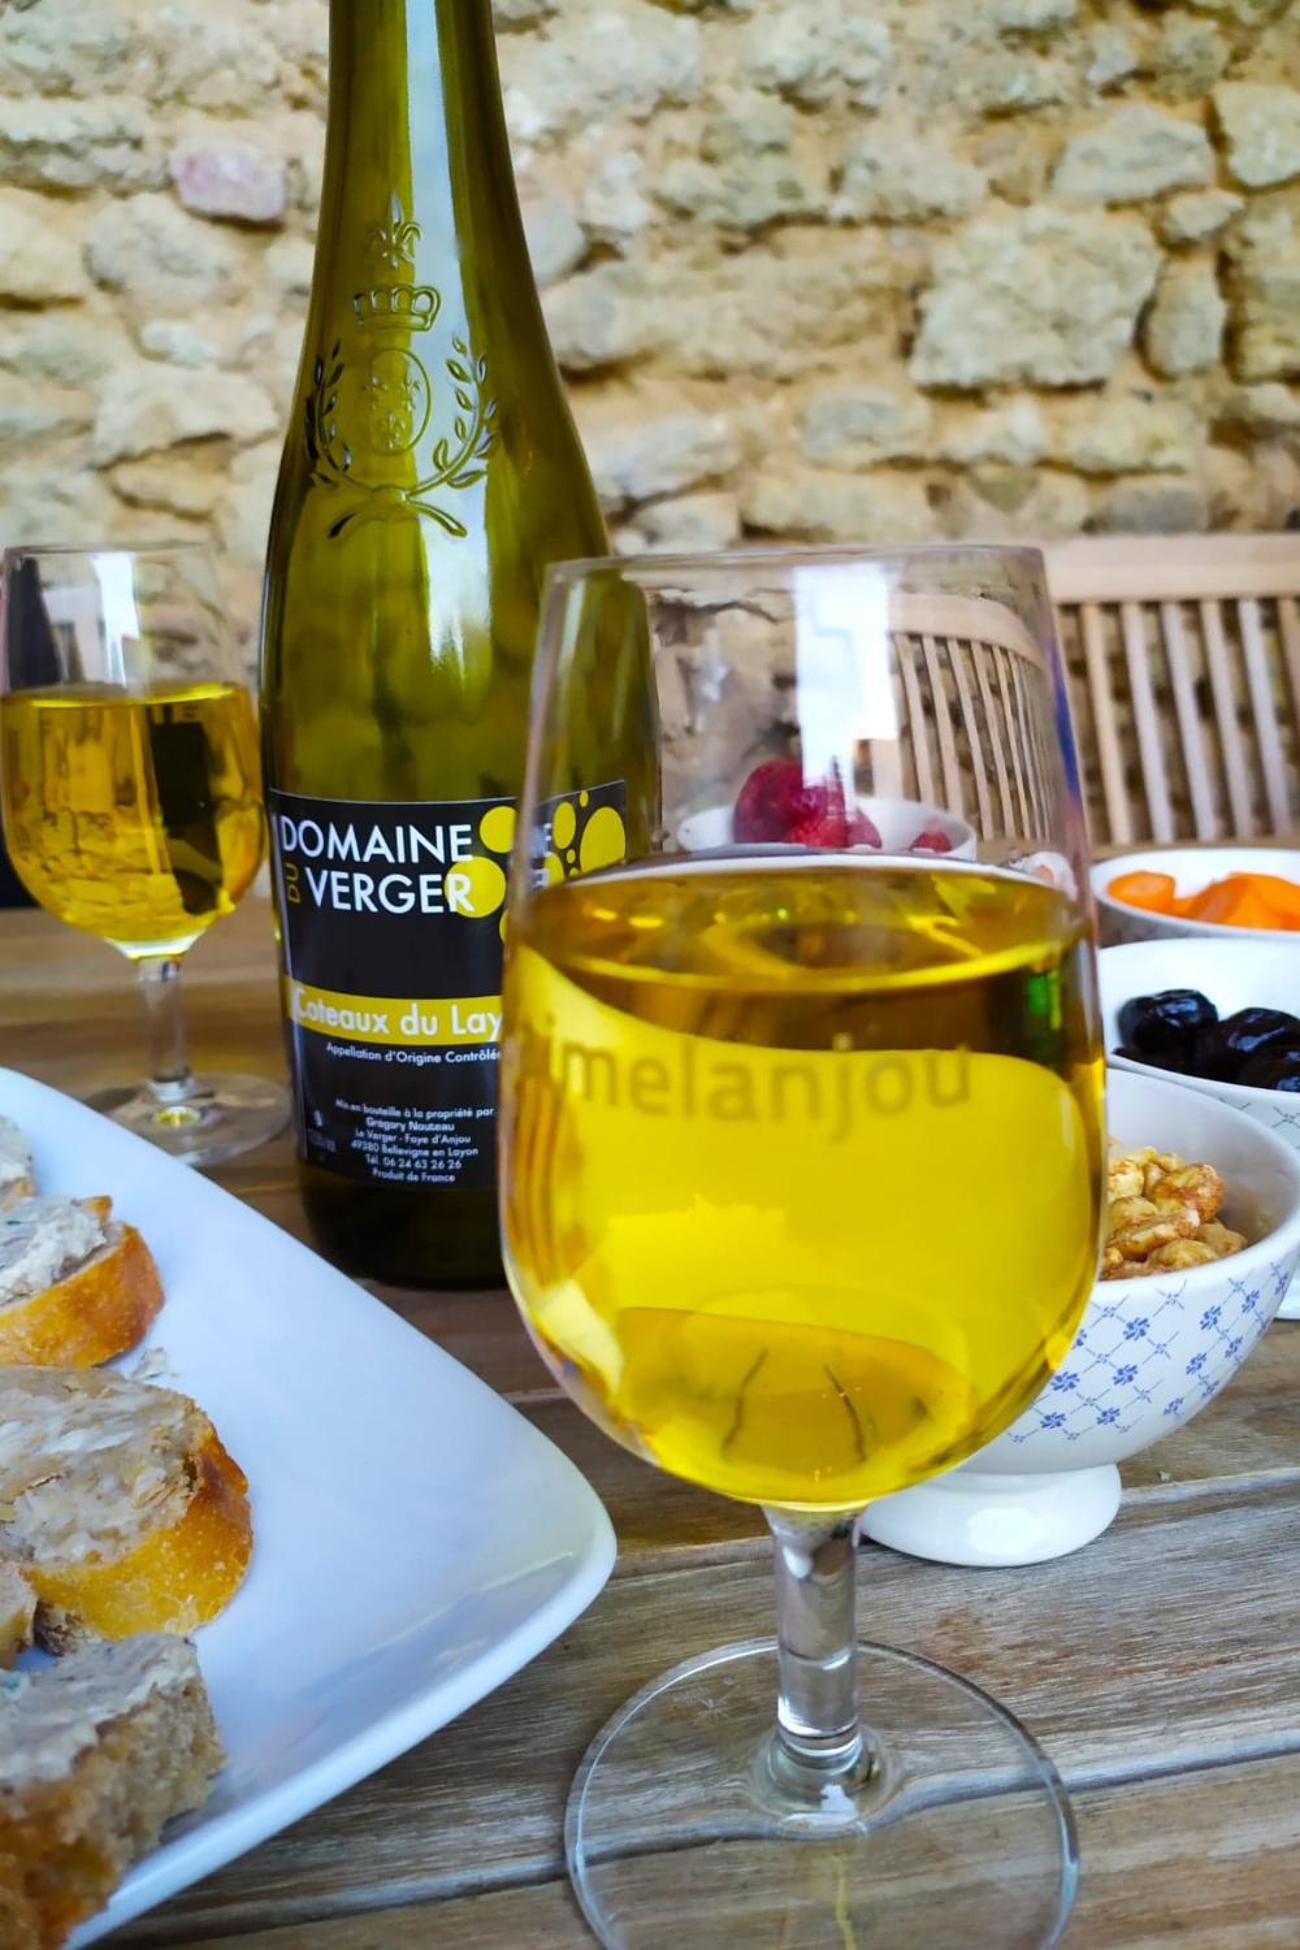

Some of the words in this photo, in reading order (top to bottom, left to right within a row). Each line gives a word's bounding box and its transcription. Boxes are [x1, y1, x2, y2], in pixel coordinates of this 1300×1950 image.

[279, 814, 474, 864] DOMAINE
[284, 862, 301, 904] DU
[304, 866, 475, 914] VERGER
[293, 988, 390, 1035] Coteaux
[401, 1003, 438, 1036] du
[451, 1004, 503, 1043] Lay
[326, 1042, 382, 1061] Appellation
[384, 1049, 442, 1066] d'Origine
[550, 1026, 970, 1143] melanjou
[363, 1103, 401, 1117] bouteille
[413, 1107, 424, 1118] la
[426, 1108, 473, 1120] propriété
[476, 1107, 495, 1119] par
[367, 1130, 397, 1143] Verger
[405, 1134, 429, 1147] Faye
[431, 1134, 471, 1145] d'Anjou
[381, 1144, 430, 1158] Bellevigne
[432, 1149, 445, 1157] en
[447, 1147, 479, 1159] Layon
[383, 1157, 396, 1168] 06
[398, 1158, 412, 1169] 24
[414, 1159, 428, 1169] 63
[431, 1159, 445, 1169] 26
[448, 1158, 462, 1170] 26
[372, 1167, 405, 1181] Produit
[407, 1171, 419, 1182] de
[421, 1171, 456, 1183] France
